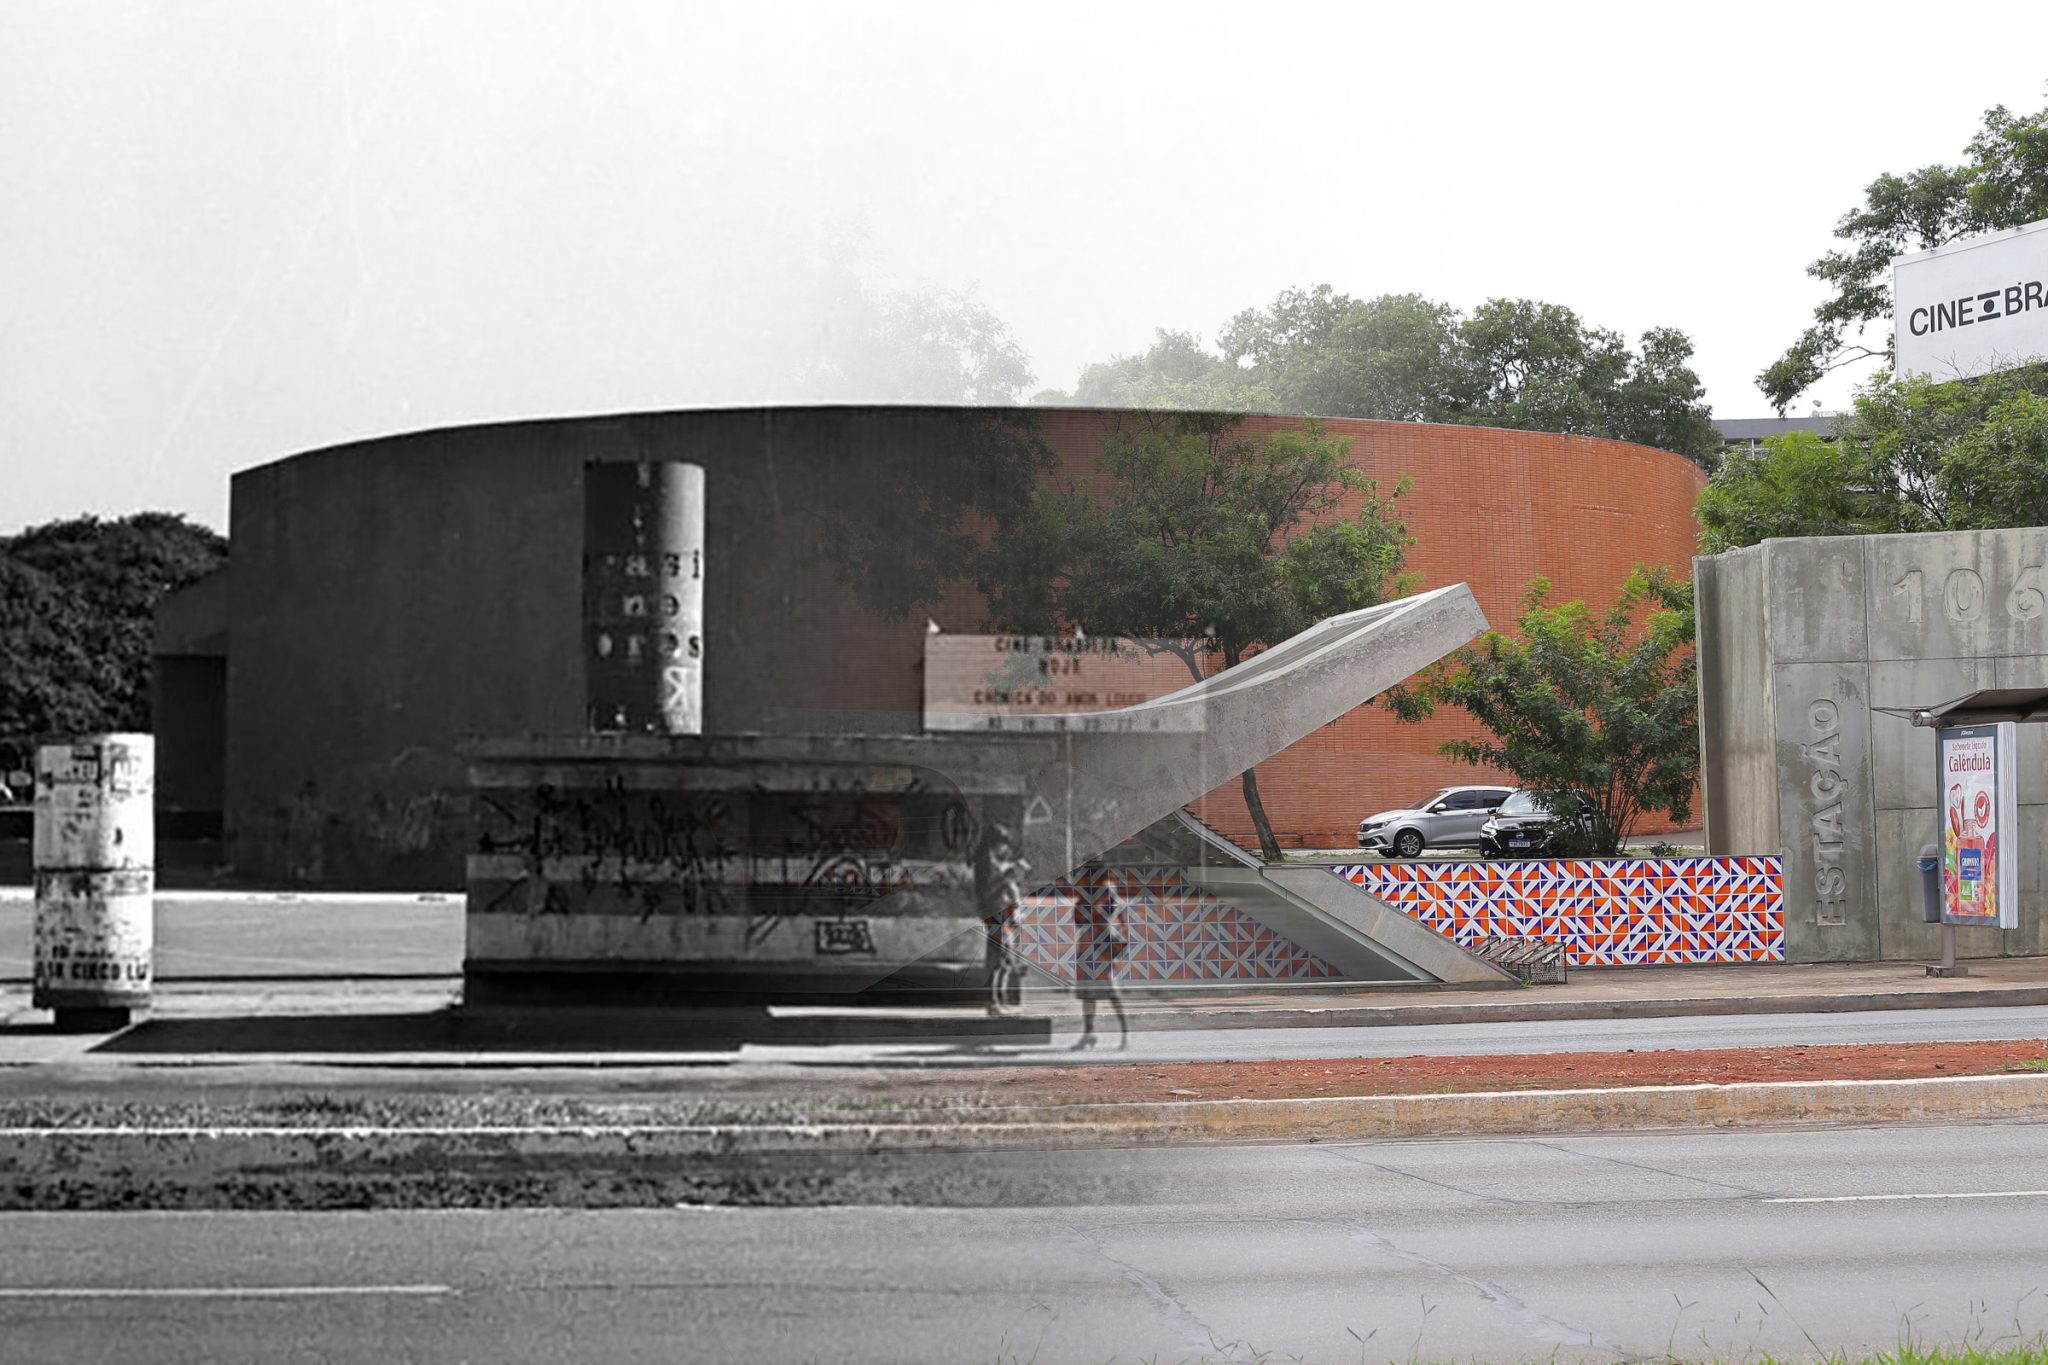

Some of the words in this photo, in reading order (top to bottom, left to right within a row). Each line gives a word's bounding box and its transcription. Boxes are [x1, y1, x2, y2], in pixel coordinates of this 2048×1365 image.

[1909, 296, 1975, 337] CINE
[2004, 280, 2048, 316] BR
[1892, 565, 2045, 623] 106
[1948, 752, 1991, 773] Calêndula
[1801, 698, 1848, 926] ESTAÇÃO
